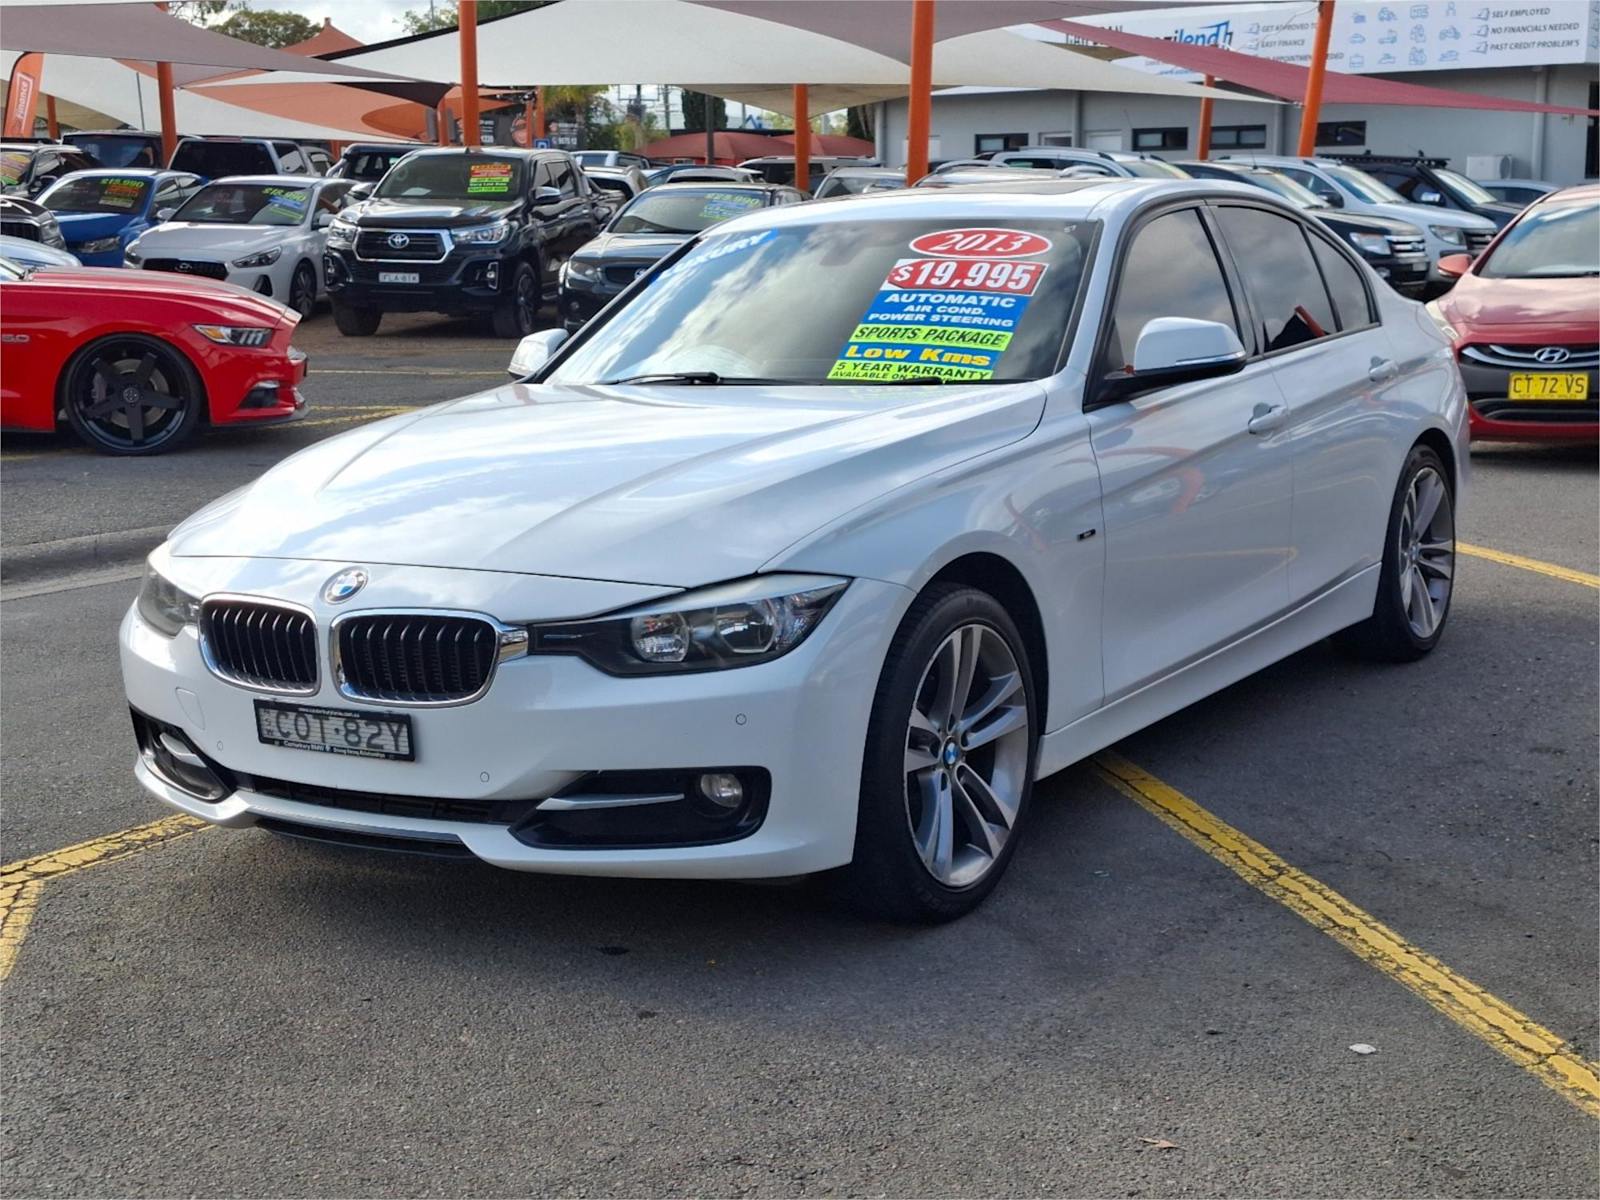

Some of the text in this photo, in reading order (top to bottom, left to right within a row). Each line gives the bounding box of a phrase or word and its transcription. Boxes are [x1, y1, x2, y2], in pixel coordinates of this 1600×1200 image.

[1491, 8, 1550, 18] SELF EMPLOYED
[1504, 24, 1547, 33] FINANCIALS
[1548, 22, 1580, 31] NEEDED
[1261, 39, 1305, 48] EASY FINANCE
[1509, 41, 1535, 50] CREDIT
[1536, 39, 1580, 48] PROBLEM'S
[928, 232, 1028, 253] 2013
[893, 261, 1036, 291] $19,995
[884, 292, 1017, 309] AUTOMATIC
[904, 304, 986, 316] AIR COND.
[868, 312, 1013, 328] POWER STEERING
[855, 326, 1005, 346] SPORTS PACKAGE
[845, 345, 991, 366] Low Kms
[831, 371, 889, 380] AVAILABLE
[836, 362, 846, 371] 5
[852, 362, 892, 372] YEAR
[897, 364, 990, 380] WARRANTY
[1513, 377, 1585, 393] CT 72 VS
